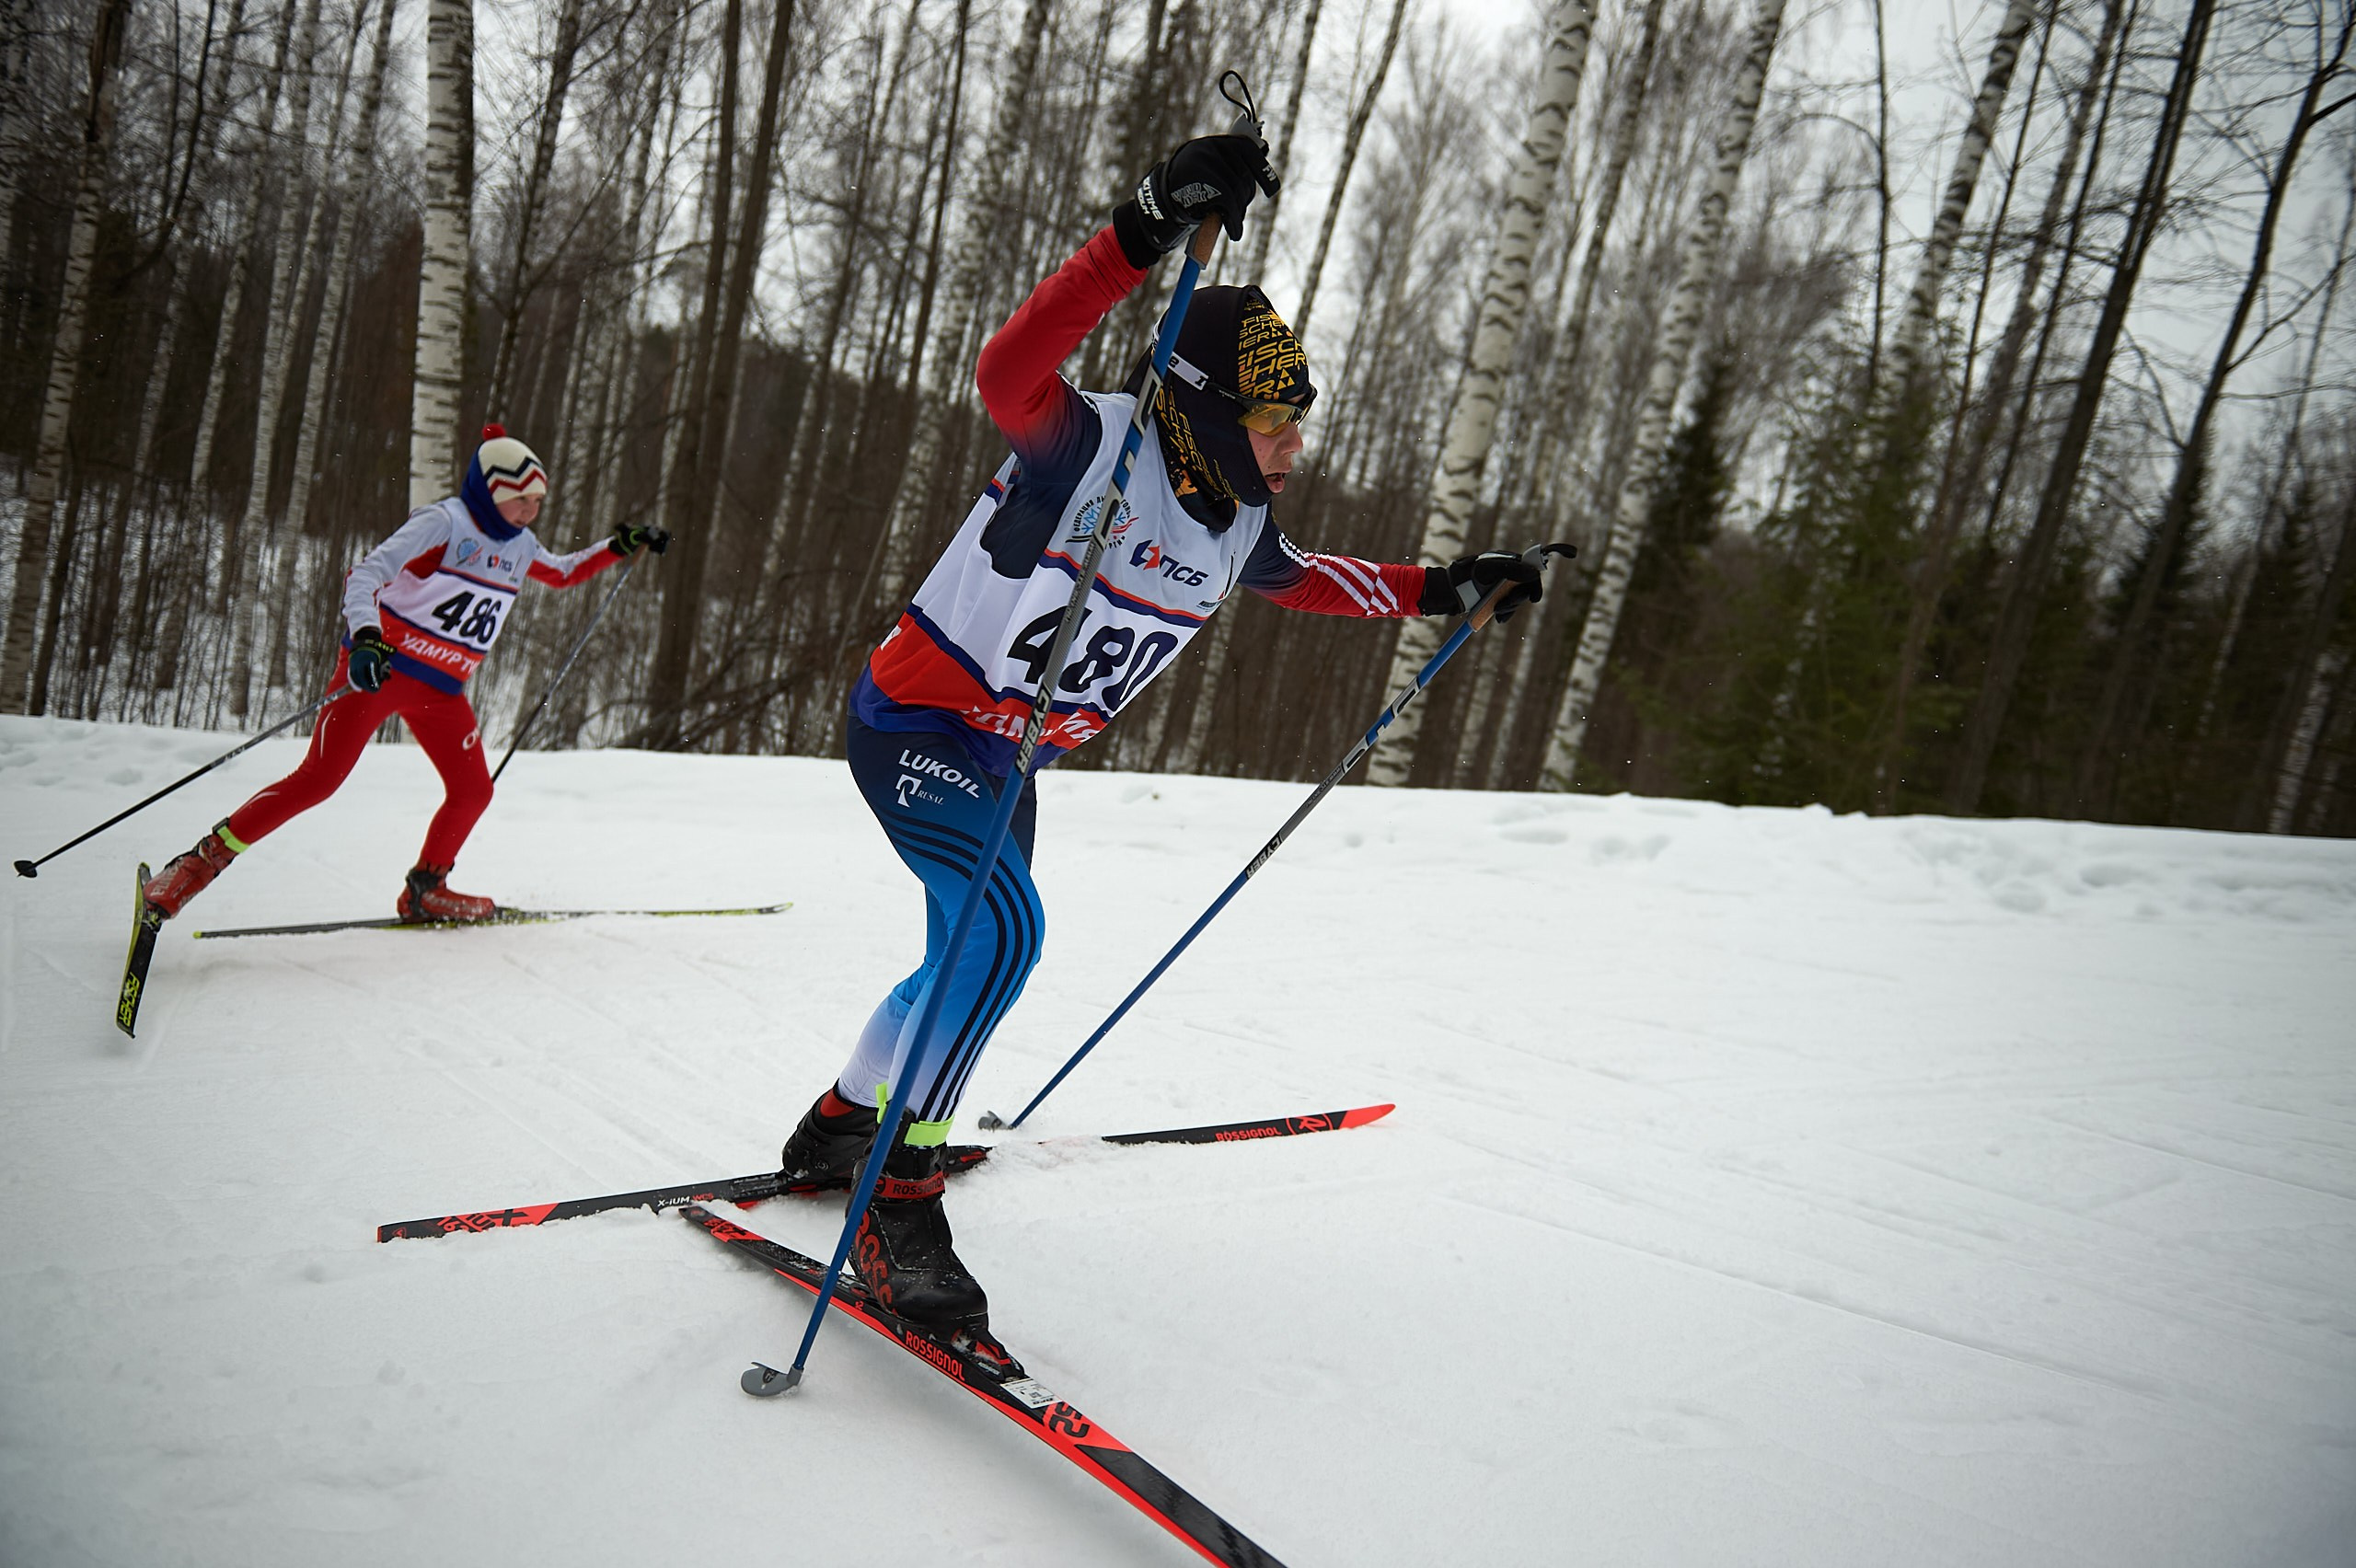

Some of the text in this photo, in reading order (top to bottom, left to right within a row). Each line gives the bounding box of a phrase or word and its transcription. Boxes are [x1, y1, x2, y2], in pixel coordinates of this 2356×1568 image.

[1160, 554, 1209, 587] ПСБ
[432, 590, 502, 644] 486
[1007, 605, 1179, 716] 480
[1015, 688, 1049, 774] CYBER
[898, 748, 981, 799] LUKOIL
[918, 789, 944, 805] RUSAL
[1246, 836, 1281, 879] CYBER
[119, 972, 140, 1028] FISCHER
[1215, 1125, 1282, 1142] ROSSIGNOL
[893, 1173, 946, 1195] ROSSIGNO
[906, 1330, 965, 1381] ROSSIGNOL
